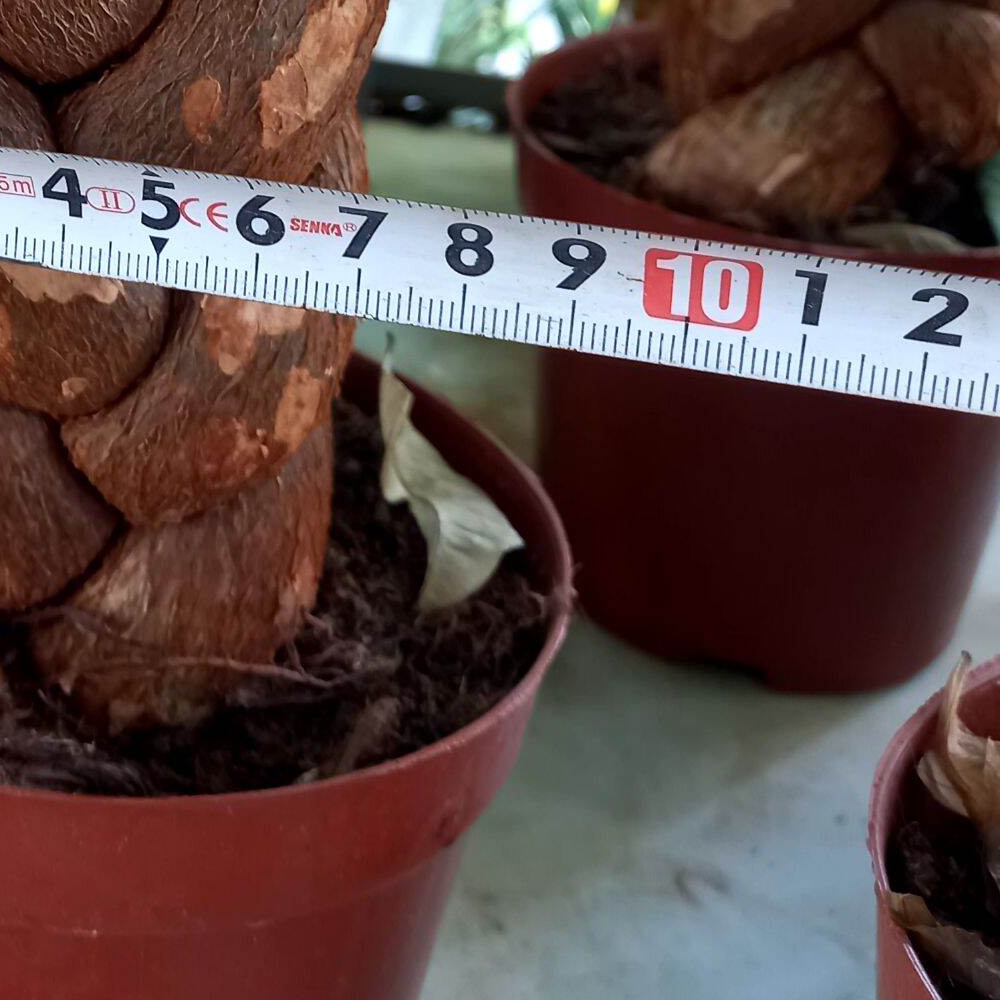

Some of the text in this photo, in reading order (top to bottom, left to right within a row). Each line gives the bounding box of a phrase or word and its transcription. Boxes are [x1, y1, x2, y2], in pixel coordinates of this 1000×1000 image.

[42, 167, 88, 219] 4
[140, 178, 181, 231] 5
[179, 197, 229, 233] CE
[236, 194, 286, 247] 6
[338, 205, 389, 260] 7
[444, 222, 495, 277] 8
[551, 237, 607, 290] 9
[656, 254, 750, 324] 10
[795, 268, 829, 326] 1
[903, 287, 970, 347] 2
